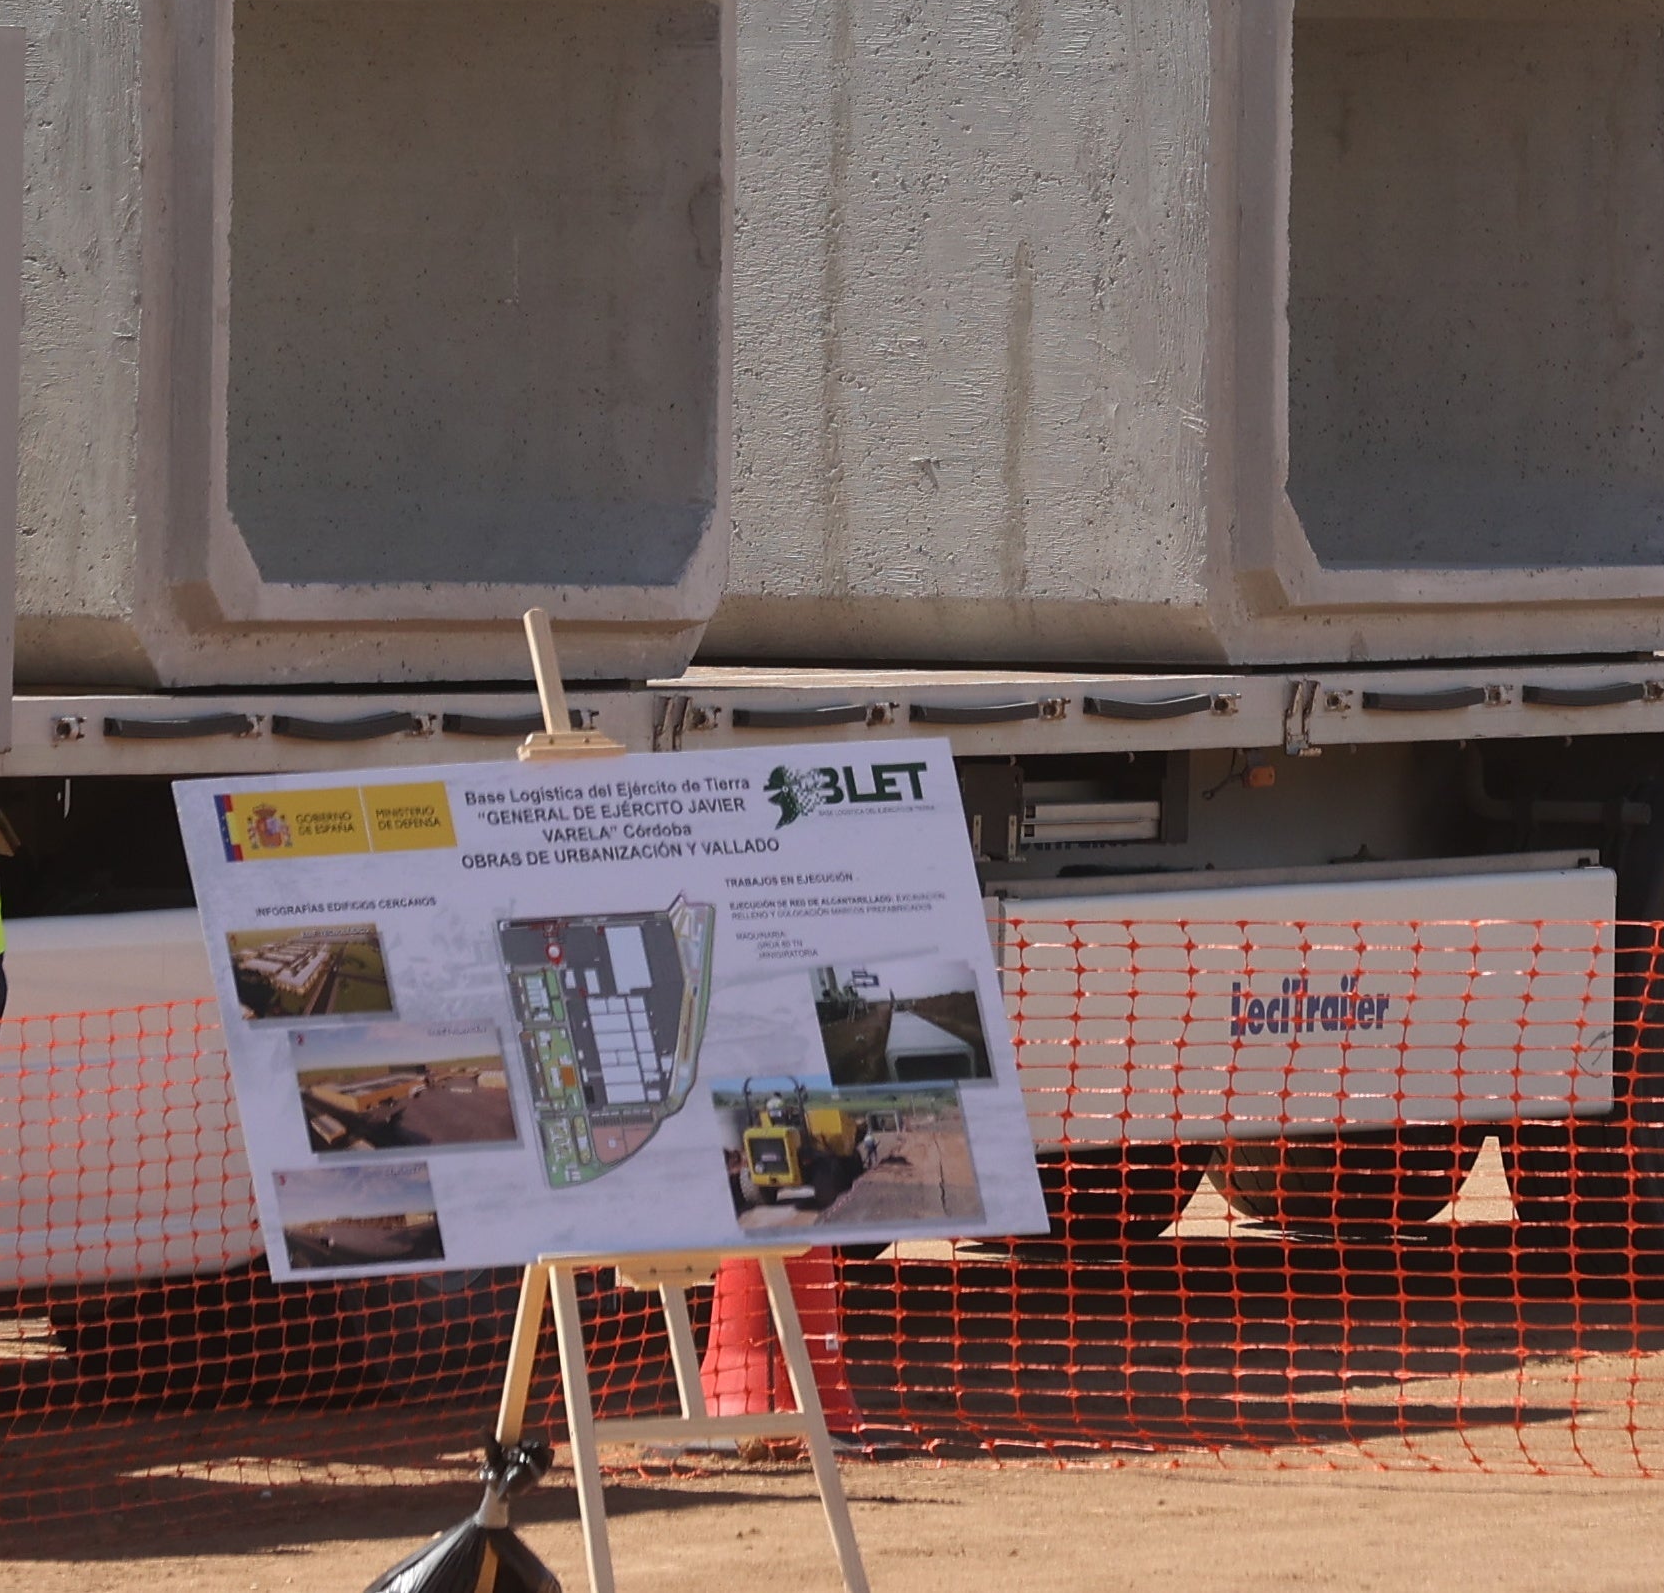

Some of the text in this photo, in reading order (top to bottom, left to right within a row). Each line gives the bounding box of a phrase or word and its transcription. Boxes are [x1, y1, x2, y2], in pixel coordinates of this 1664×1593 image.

[465, 776, 750, 806] Base Logística del Ejército de Tierra
[295, 811, 352, 823] GOBIERNO
[376, 806, 435, 819] MINISTERIO
[573, 805, 596, 820] DE
[601, 798, 683, 819] EJÉRCITO
[688, 797, 746, 814] JAVIER
[298, 822, 355, 836] DE ESPAÑA
[378, 817, 441, 831] DE DEFENSA
[623, 823, 692, 840] Córdoba
[462, 837, 780, 870] OBRAS DE URBANIZACIÓN Y VALLADO
[724, 872, 853, 889] TRABAJOS EN EJECUCIÓN
[255, 896, 437, 918] INFOGRAFÍAS EDIFICIOS CERCANOS
